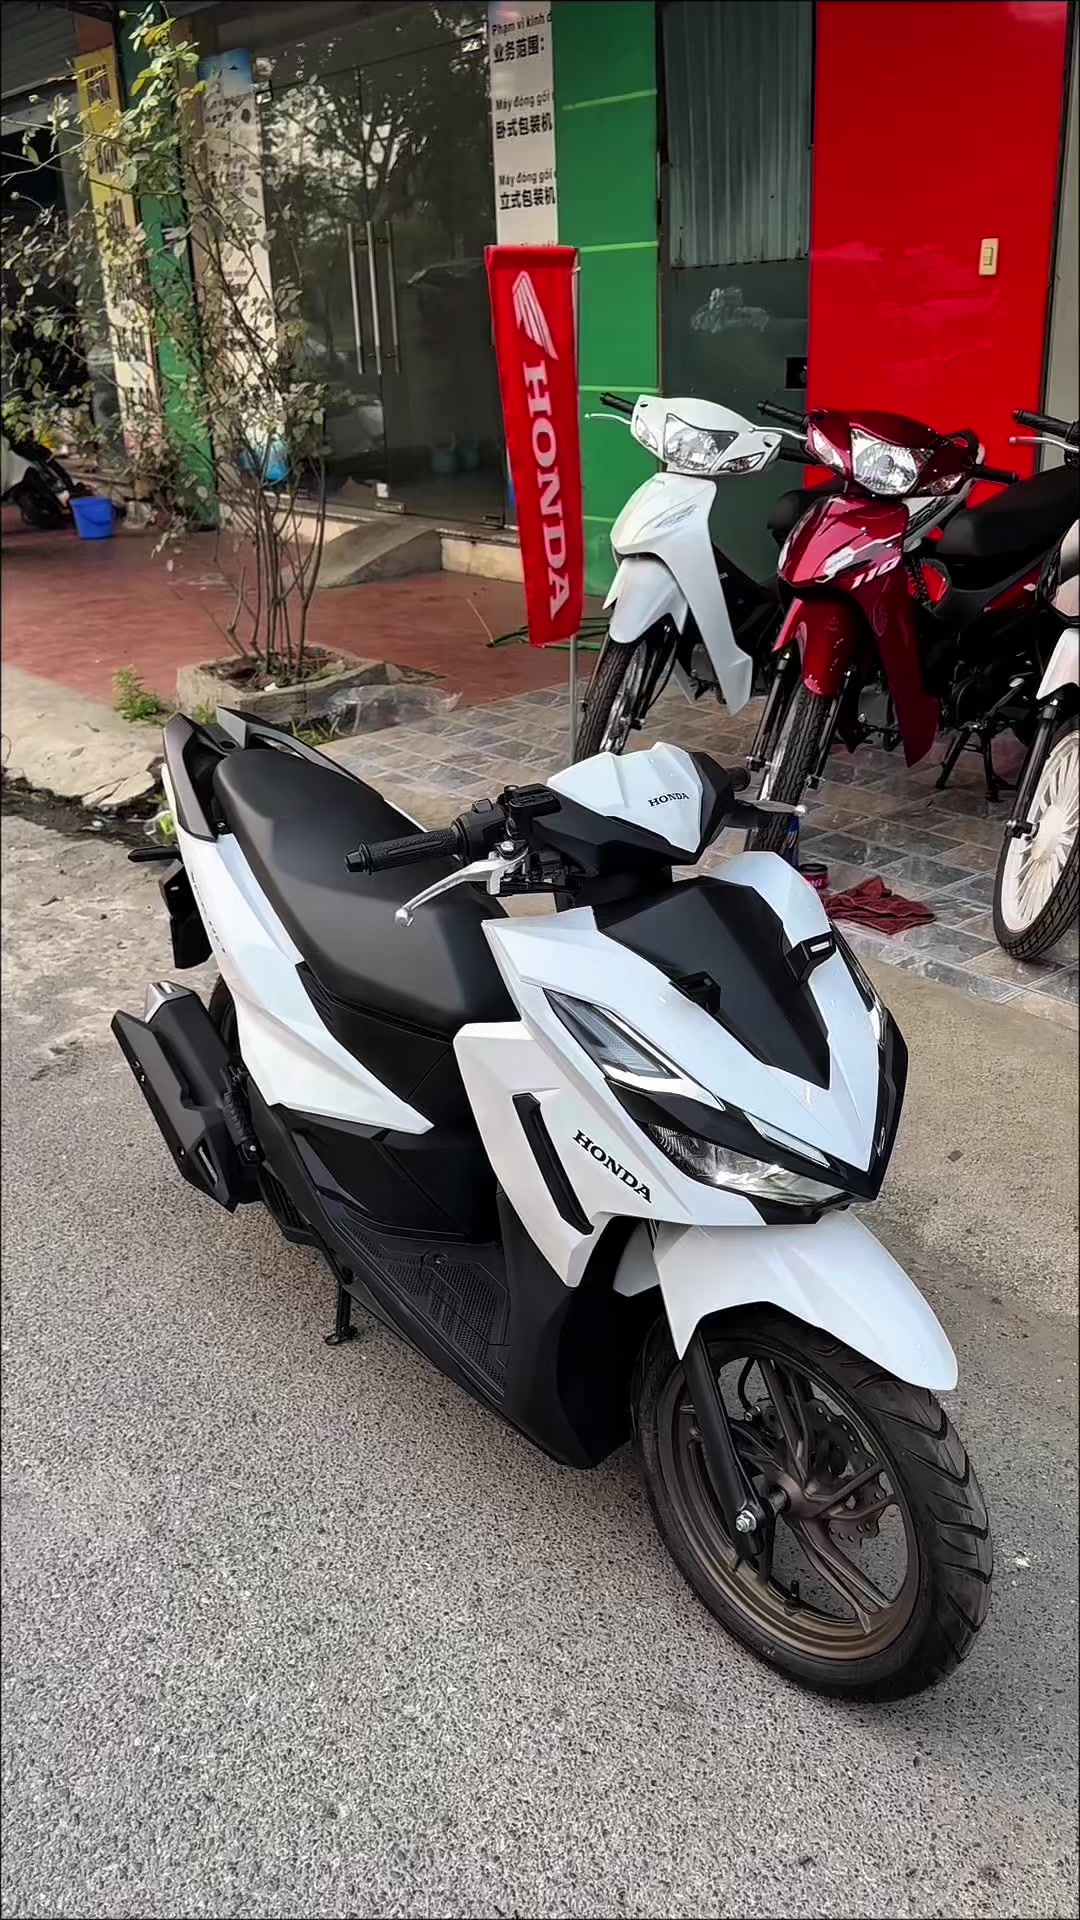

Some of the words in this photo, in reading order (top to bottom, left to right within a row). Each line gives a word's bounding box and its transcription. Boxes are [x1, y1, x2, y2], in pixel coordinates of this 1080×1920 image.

[496, 112, 552, 139] 卧式包装机
[500, 187, 555, 210] 立式包装机
[523, 360, 570, 620] HONDA
[648, 792, 690, 807] HONDA
[572, 1129, 652, 1204] HONDA
